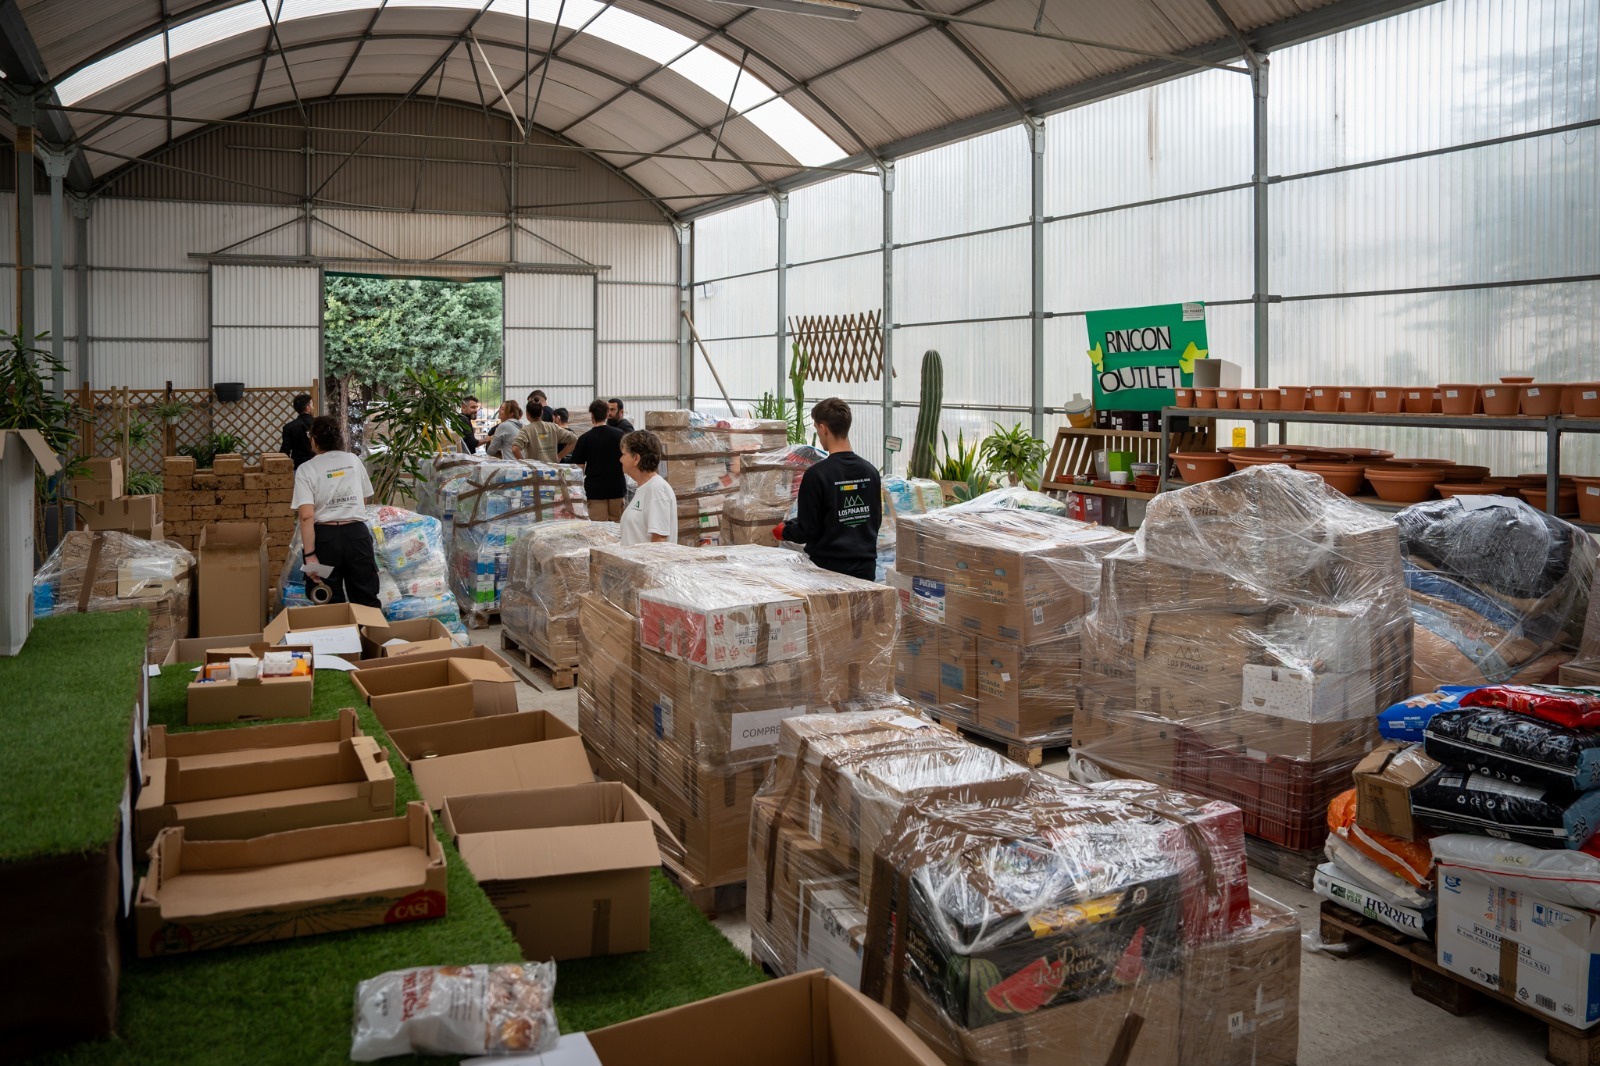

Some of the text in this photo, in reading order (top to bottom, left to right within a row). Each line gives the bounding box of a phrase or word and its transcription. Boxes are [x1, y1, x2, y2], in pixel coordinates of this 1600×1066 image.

[1105, 326, 1172, 353] RINCON
[1099, 366, 1180, 392] OUTLET
[1366, 897, 1418, 928] YARRAH
[1475, 926, 1502, 942] PEDID
